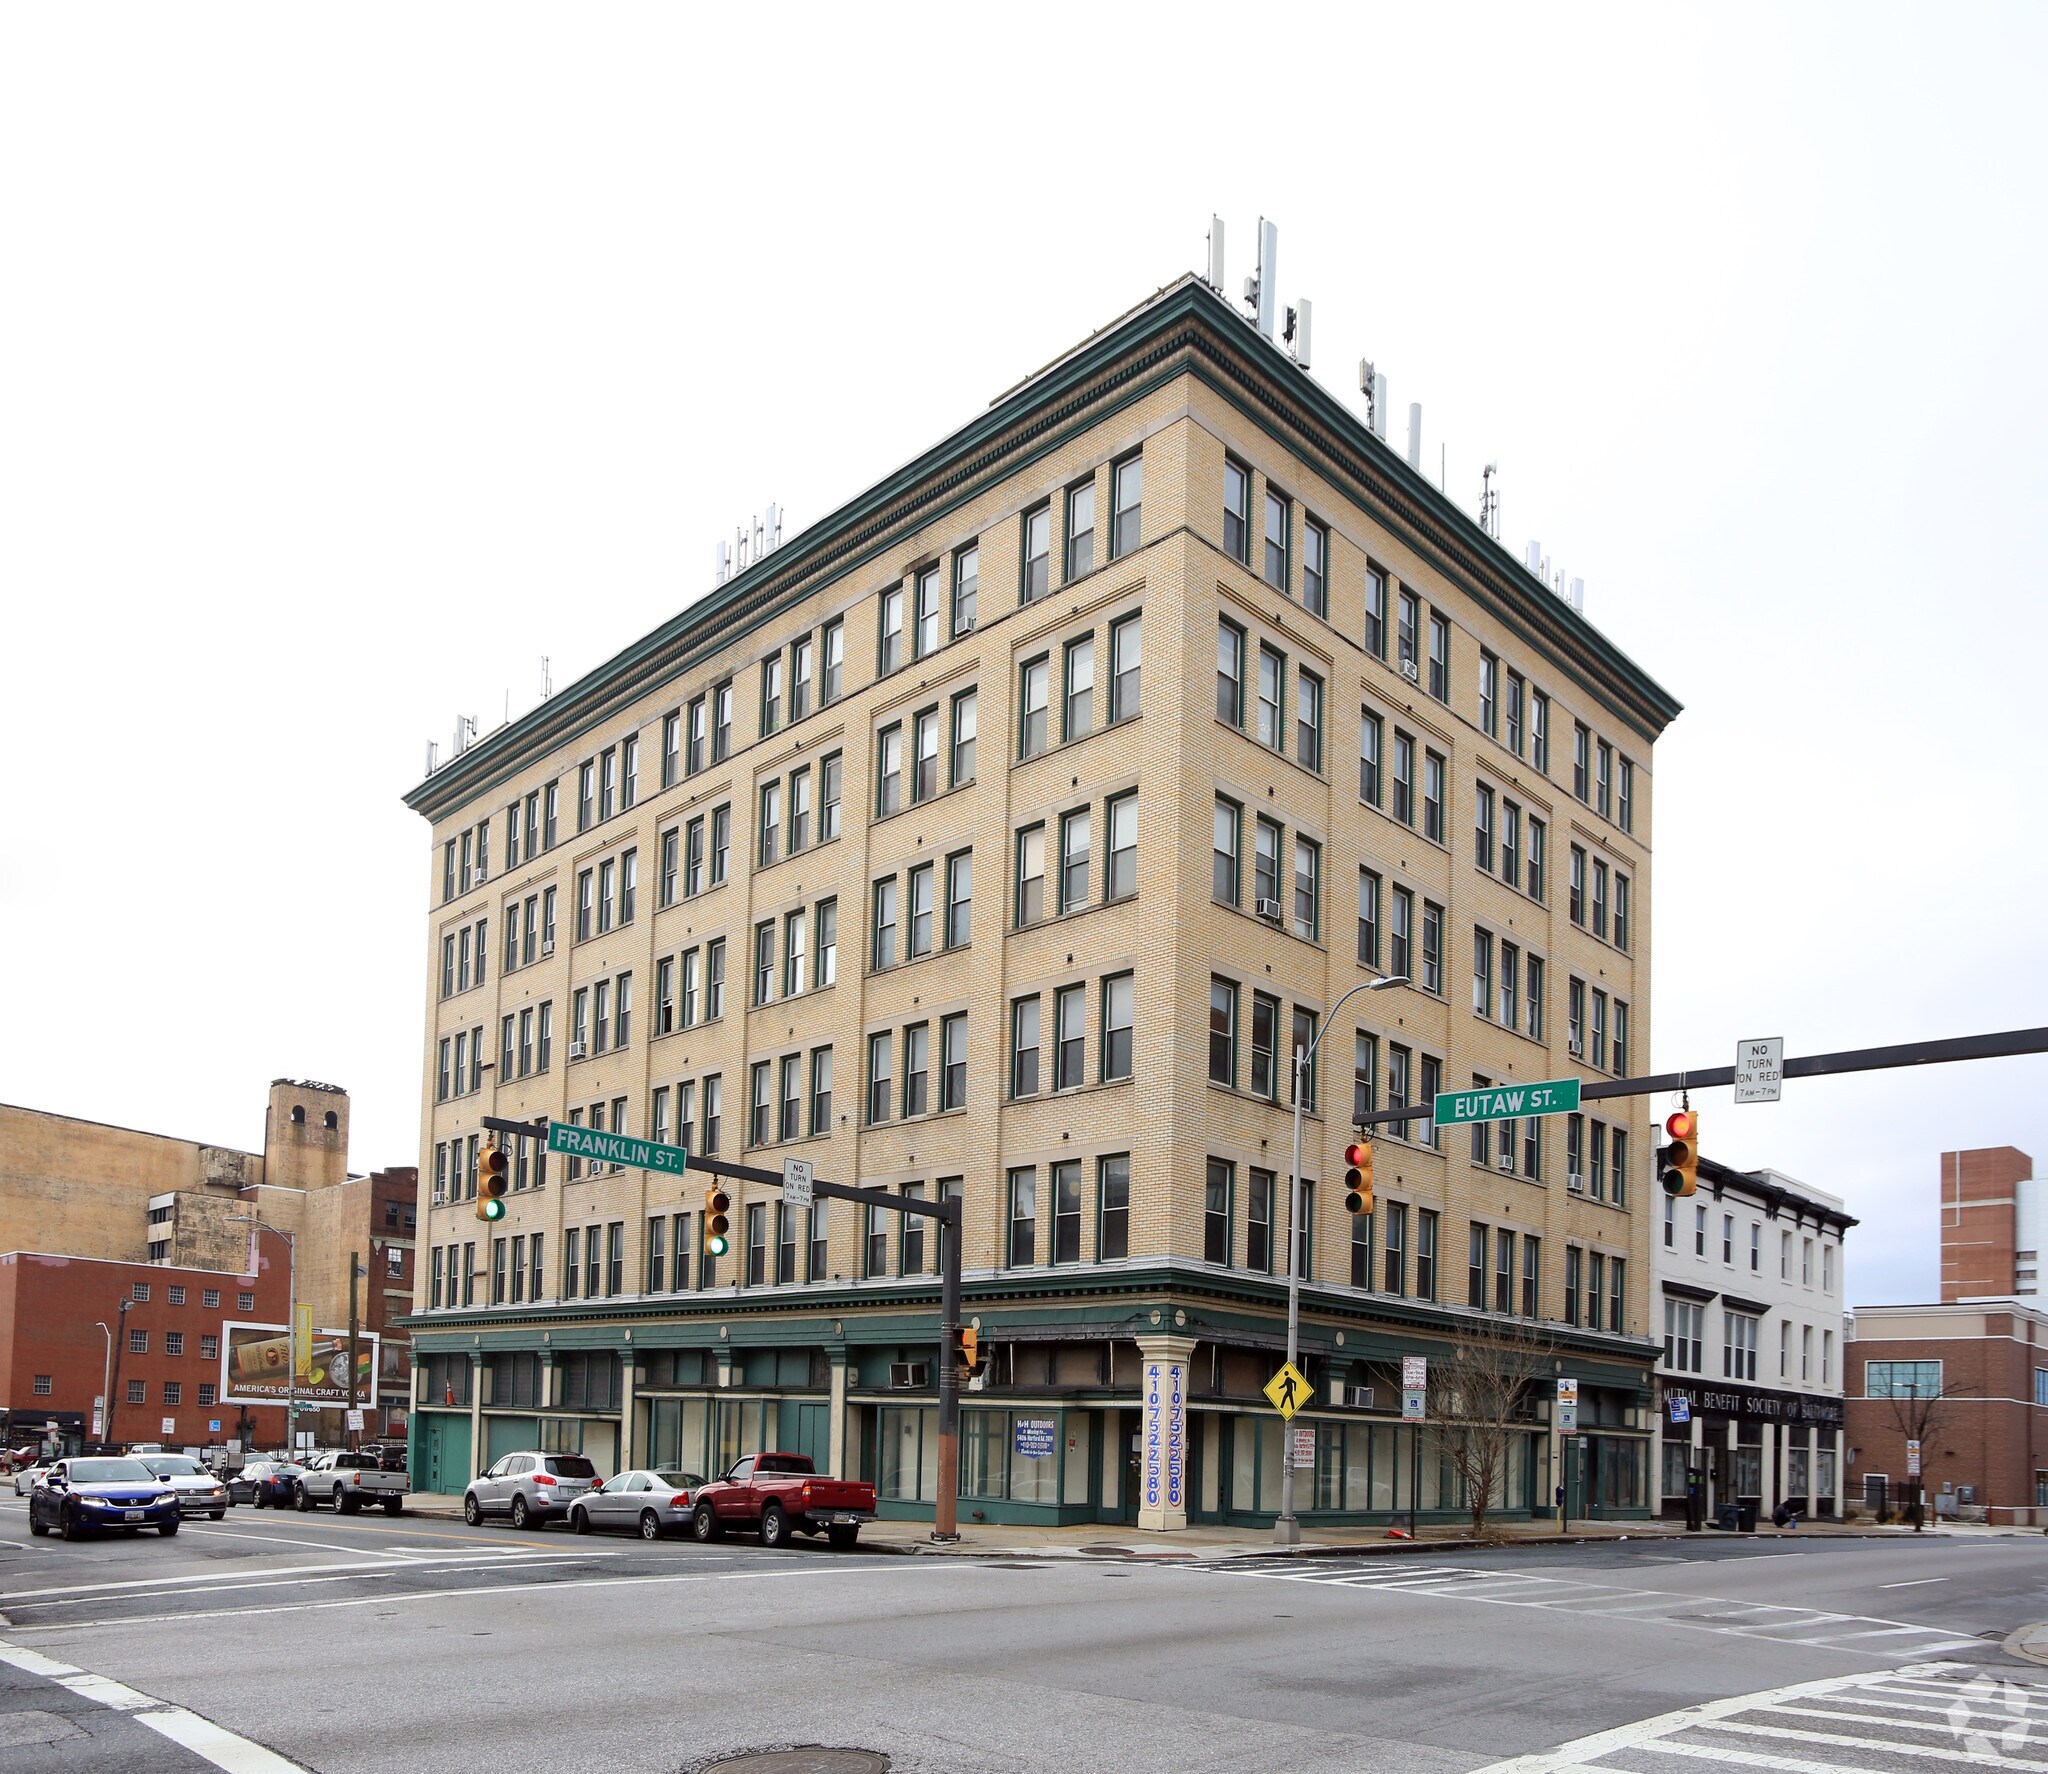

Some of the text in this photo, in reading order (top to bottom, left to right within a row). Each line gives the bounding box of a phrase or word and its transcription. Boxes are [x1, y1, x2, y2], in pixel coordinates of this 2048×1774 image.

[1752, 1045, 1768, 1055] NO
[1747, 1058, 1773, 1069] TURN
[1739, 1071, 1779, 1083] ON RED
[1455, 1089, 1557, 1118] EUTAW ST.
[556, 1128, 679, 1169] FRANKLIN ST.
[793, 1164, 804, 1173] NO
[790, 1173, 807, 1182] TURN
[785, 1181, 810, 1193] ON RED
[234, 1384, 276, 1394] AMERICA'S
[315, 1388, 340, 1397] CRAFT
[341, 1389, 365, 1398] VOKA
[1704, 1392, 1740, 1411] BENEFIT
[1746, 1397, 1780, 1415] SOCIETY
[1787, 1402, 1798, 1417] OF
[1030, 1421, 1054, 1429] OUTDOORS
